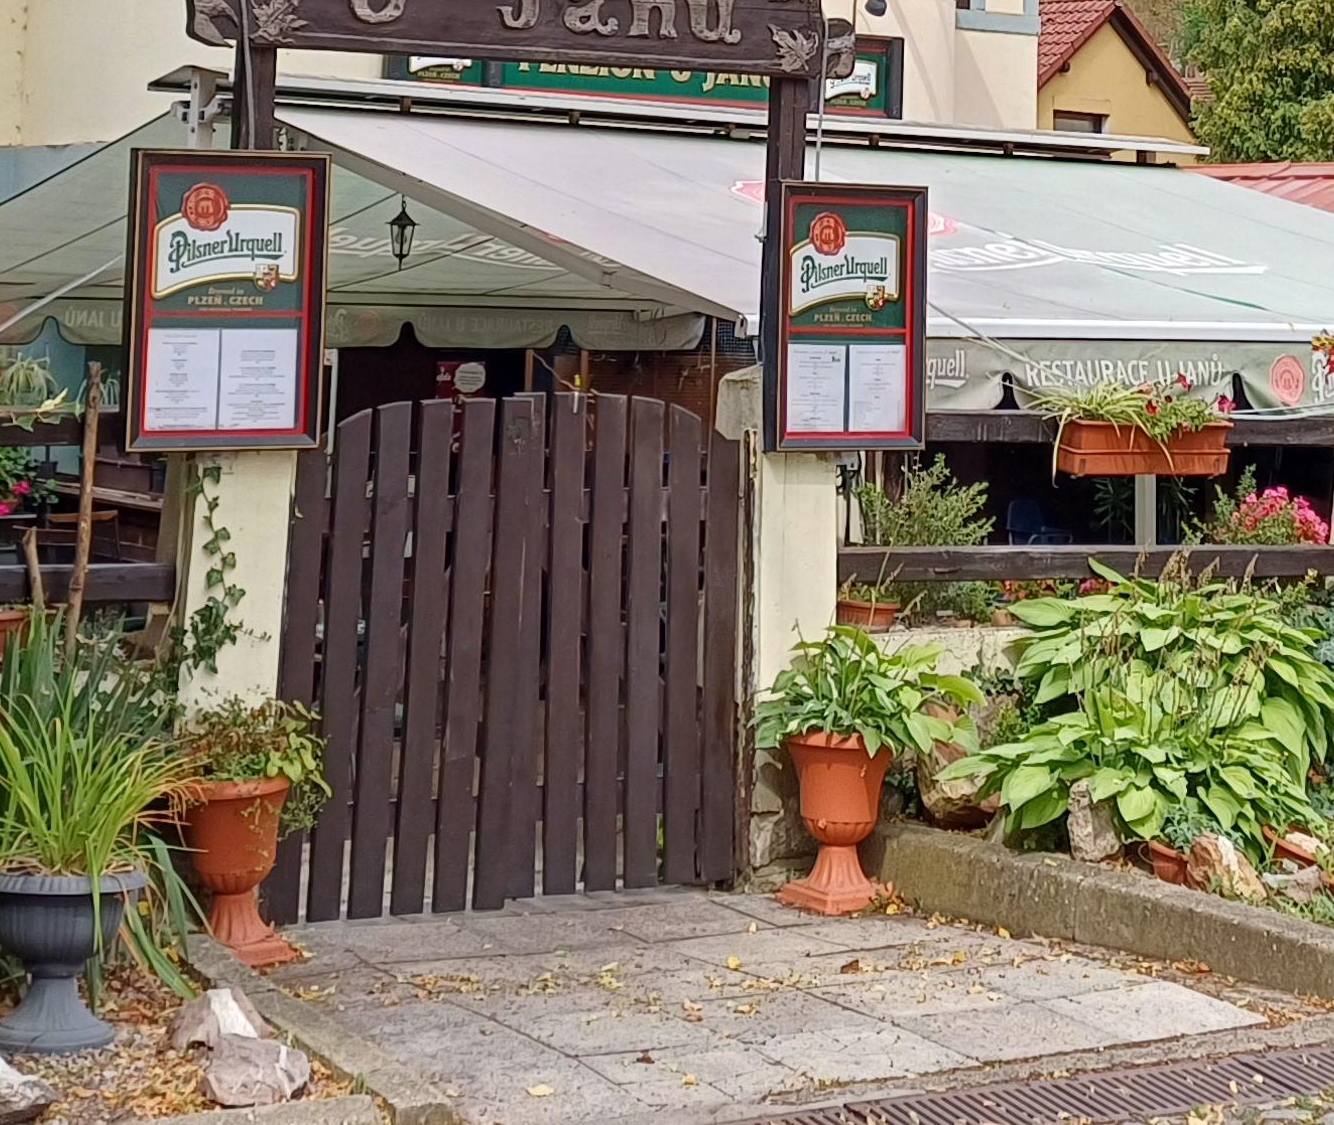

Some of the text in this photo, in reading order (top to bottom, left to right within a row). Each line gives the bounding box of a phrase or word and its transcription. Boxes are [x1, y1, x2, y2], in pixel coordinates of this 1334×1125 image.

[168, 230, 283, 273] Pilsner Urquell
[801, 254, 887, 293] Pilsner Urquell
[926, 349, 967, 388] quell
[1026, 359, 1149, 387] RESTAURACE
